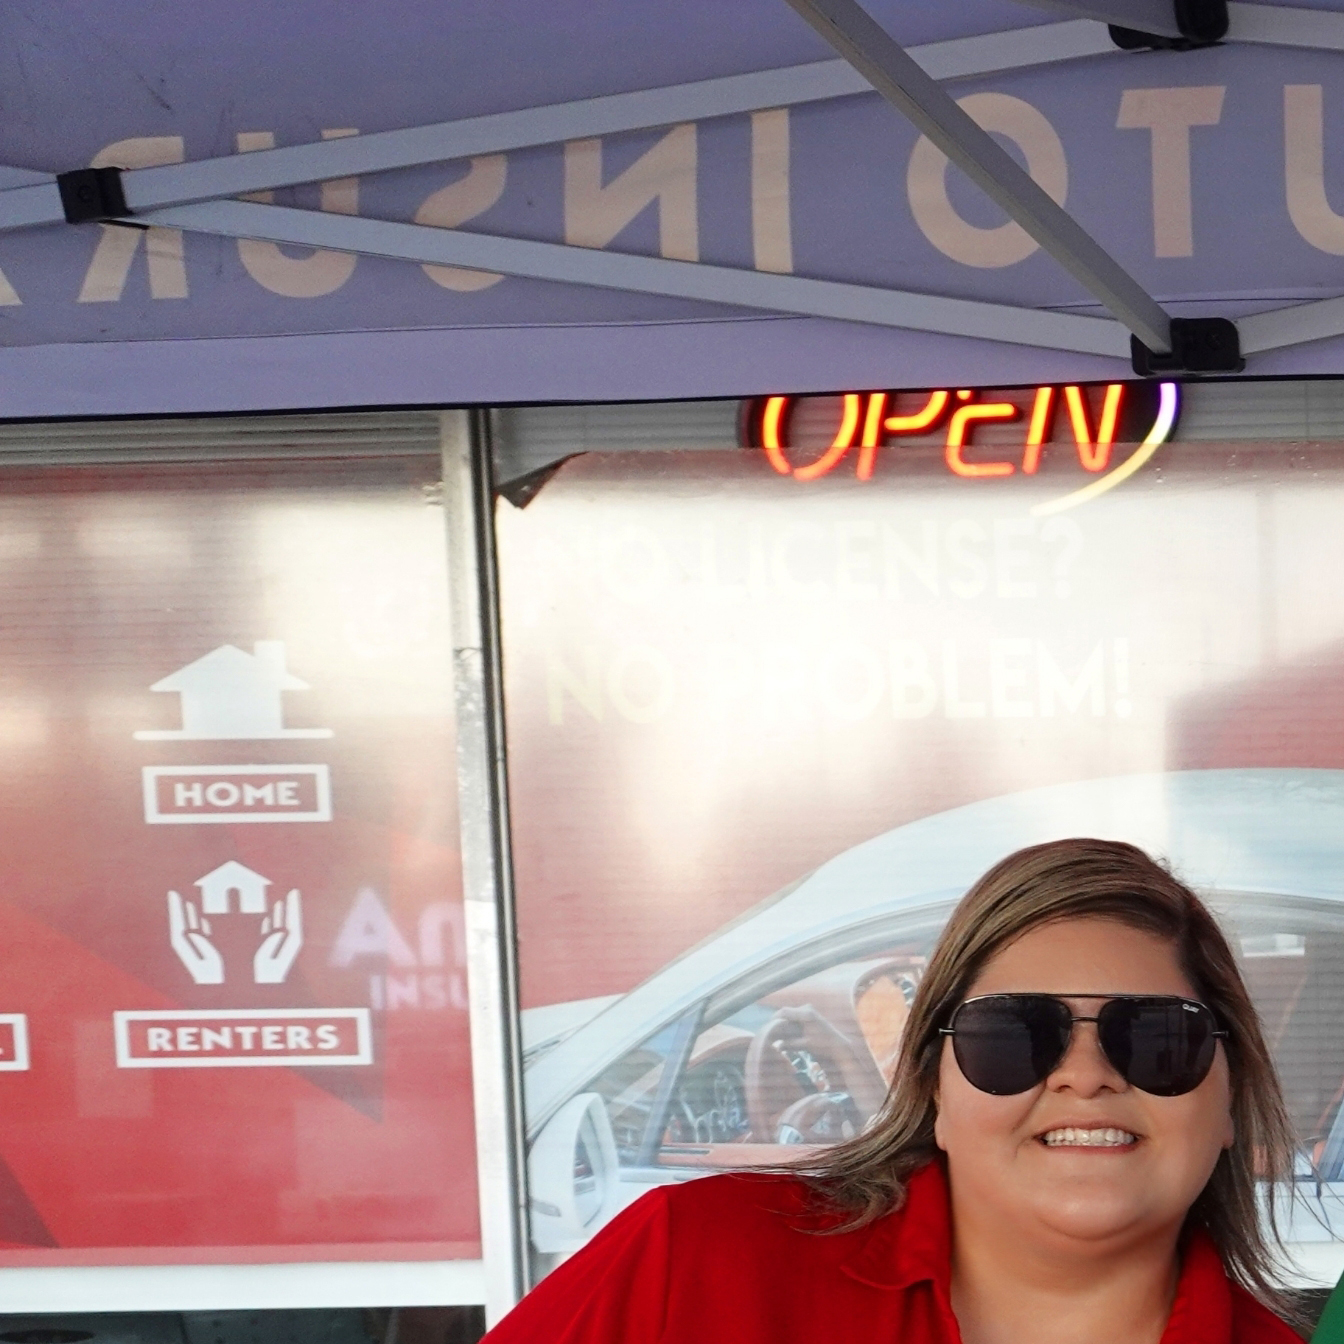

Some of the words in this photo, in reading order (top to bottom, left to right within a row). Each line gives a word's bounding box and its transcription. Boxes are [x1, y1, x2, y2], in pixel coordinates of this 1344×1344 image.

[761, 383, 1124, 481] OPEN
[173, 780, 301, 808] HOME
[147, 1024, 340, 1052] RENTERS
